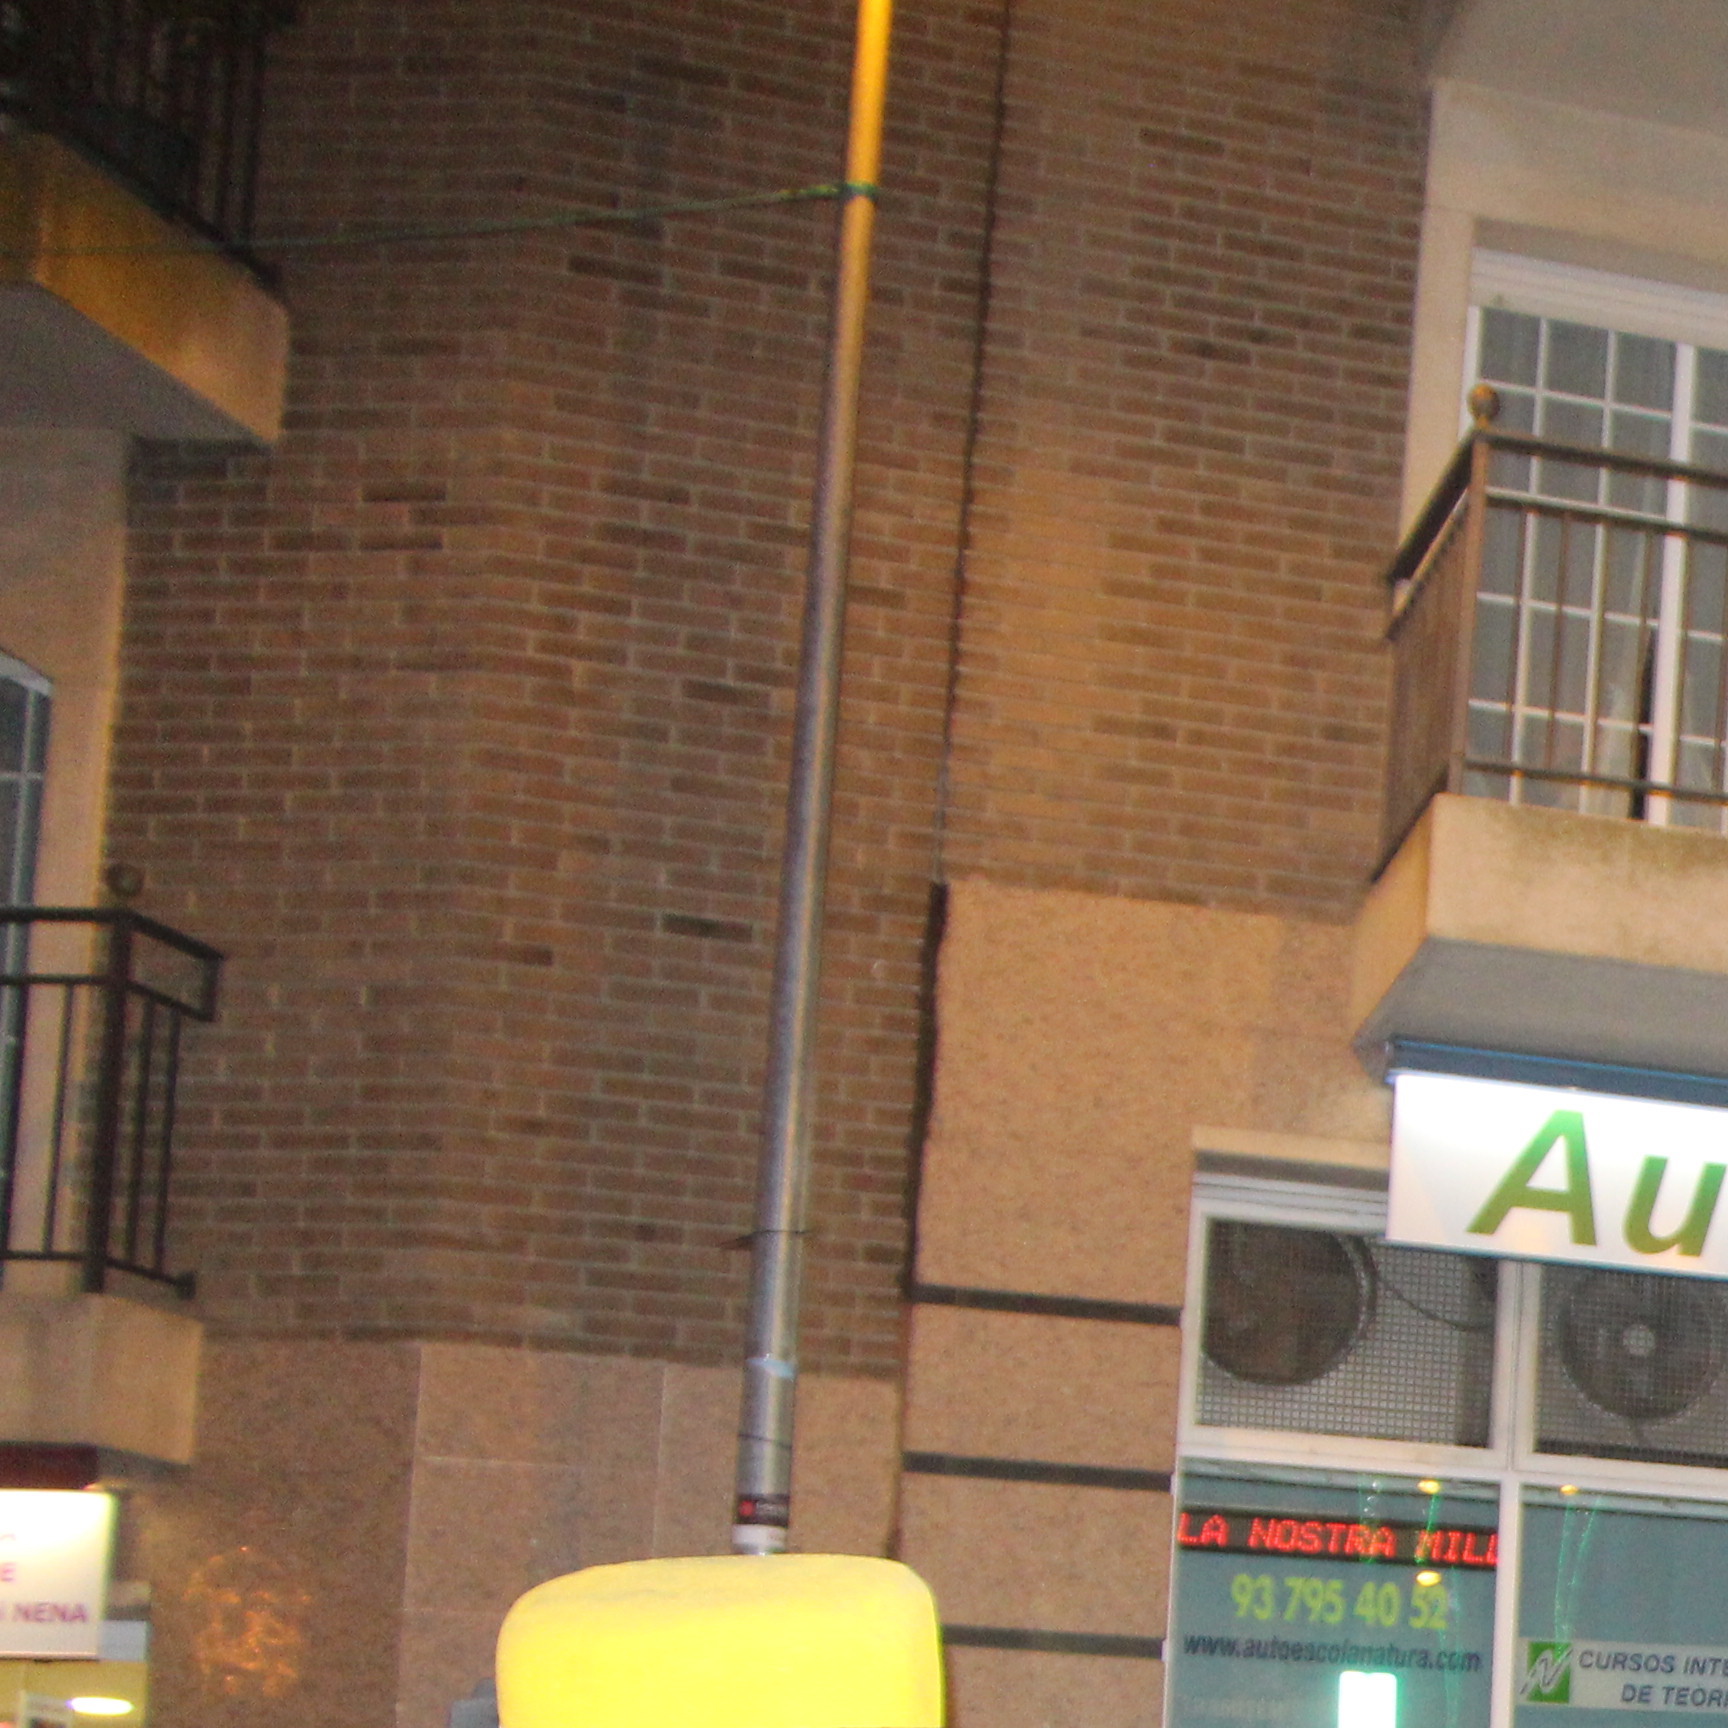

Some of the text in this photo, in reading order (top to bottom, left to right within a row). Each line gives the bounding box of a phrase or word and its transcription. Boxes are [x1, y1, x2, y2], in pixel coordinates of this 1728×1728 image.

[1177, 1511, 1229, 1548] LA
[1248, 1516, 1397, 1558] NOSTRA
[1231, 1572, 1448, 1631] 93 795 40 52
[1578, 1648, 1675, 1674] CURSOS
[1620, 1682, 1655, 1704] DE
